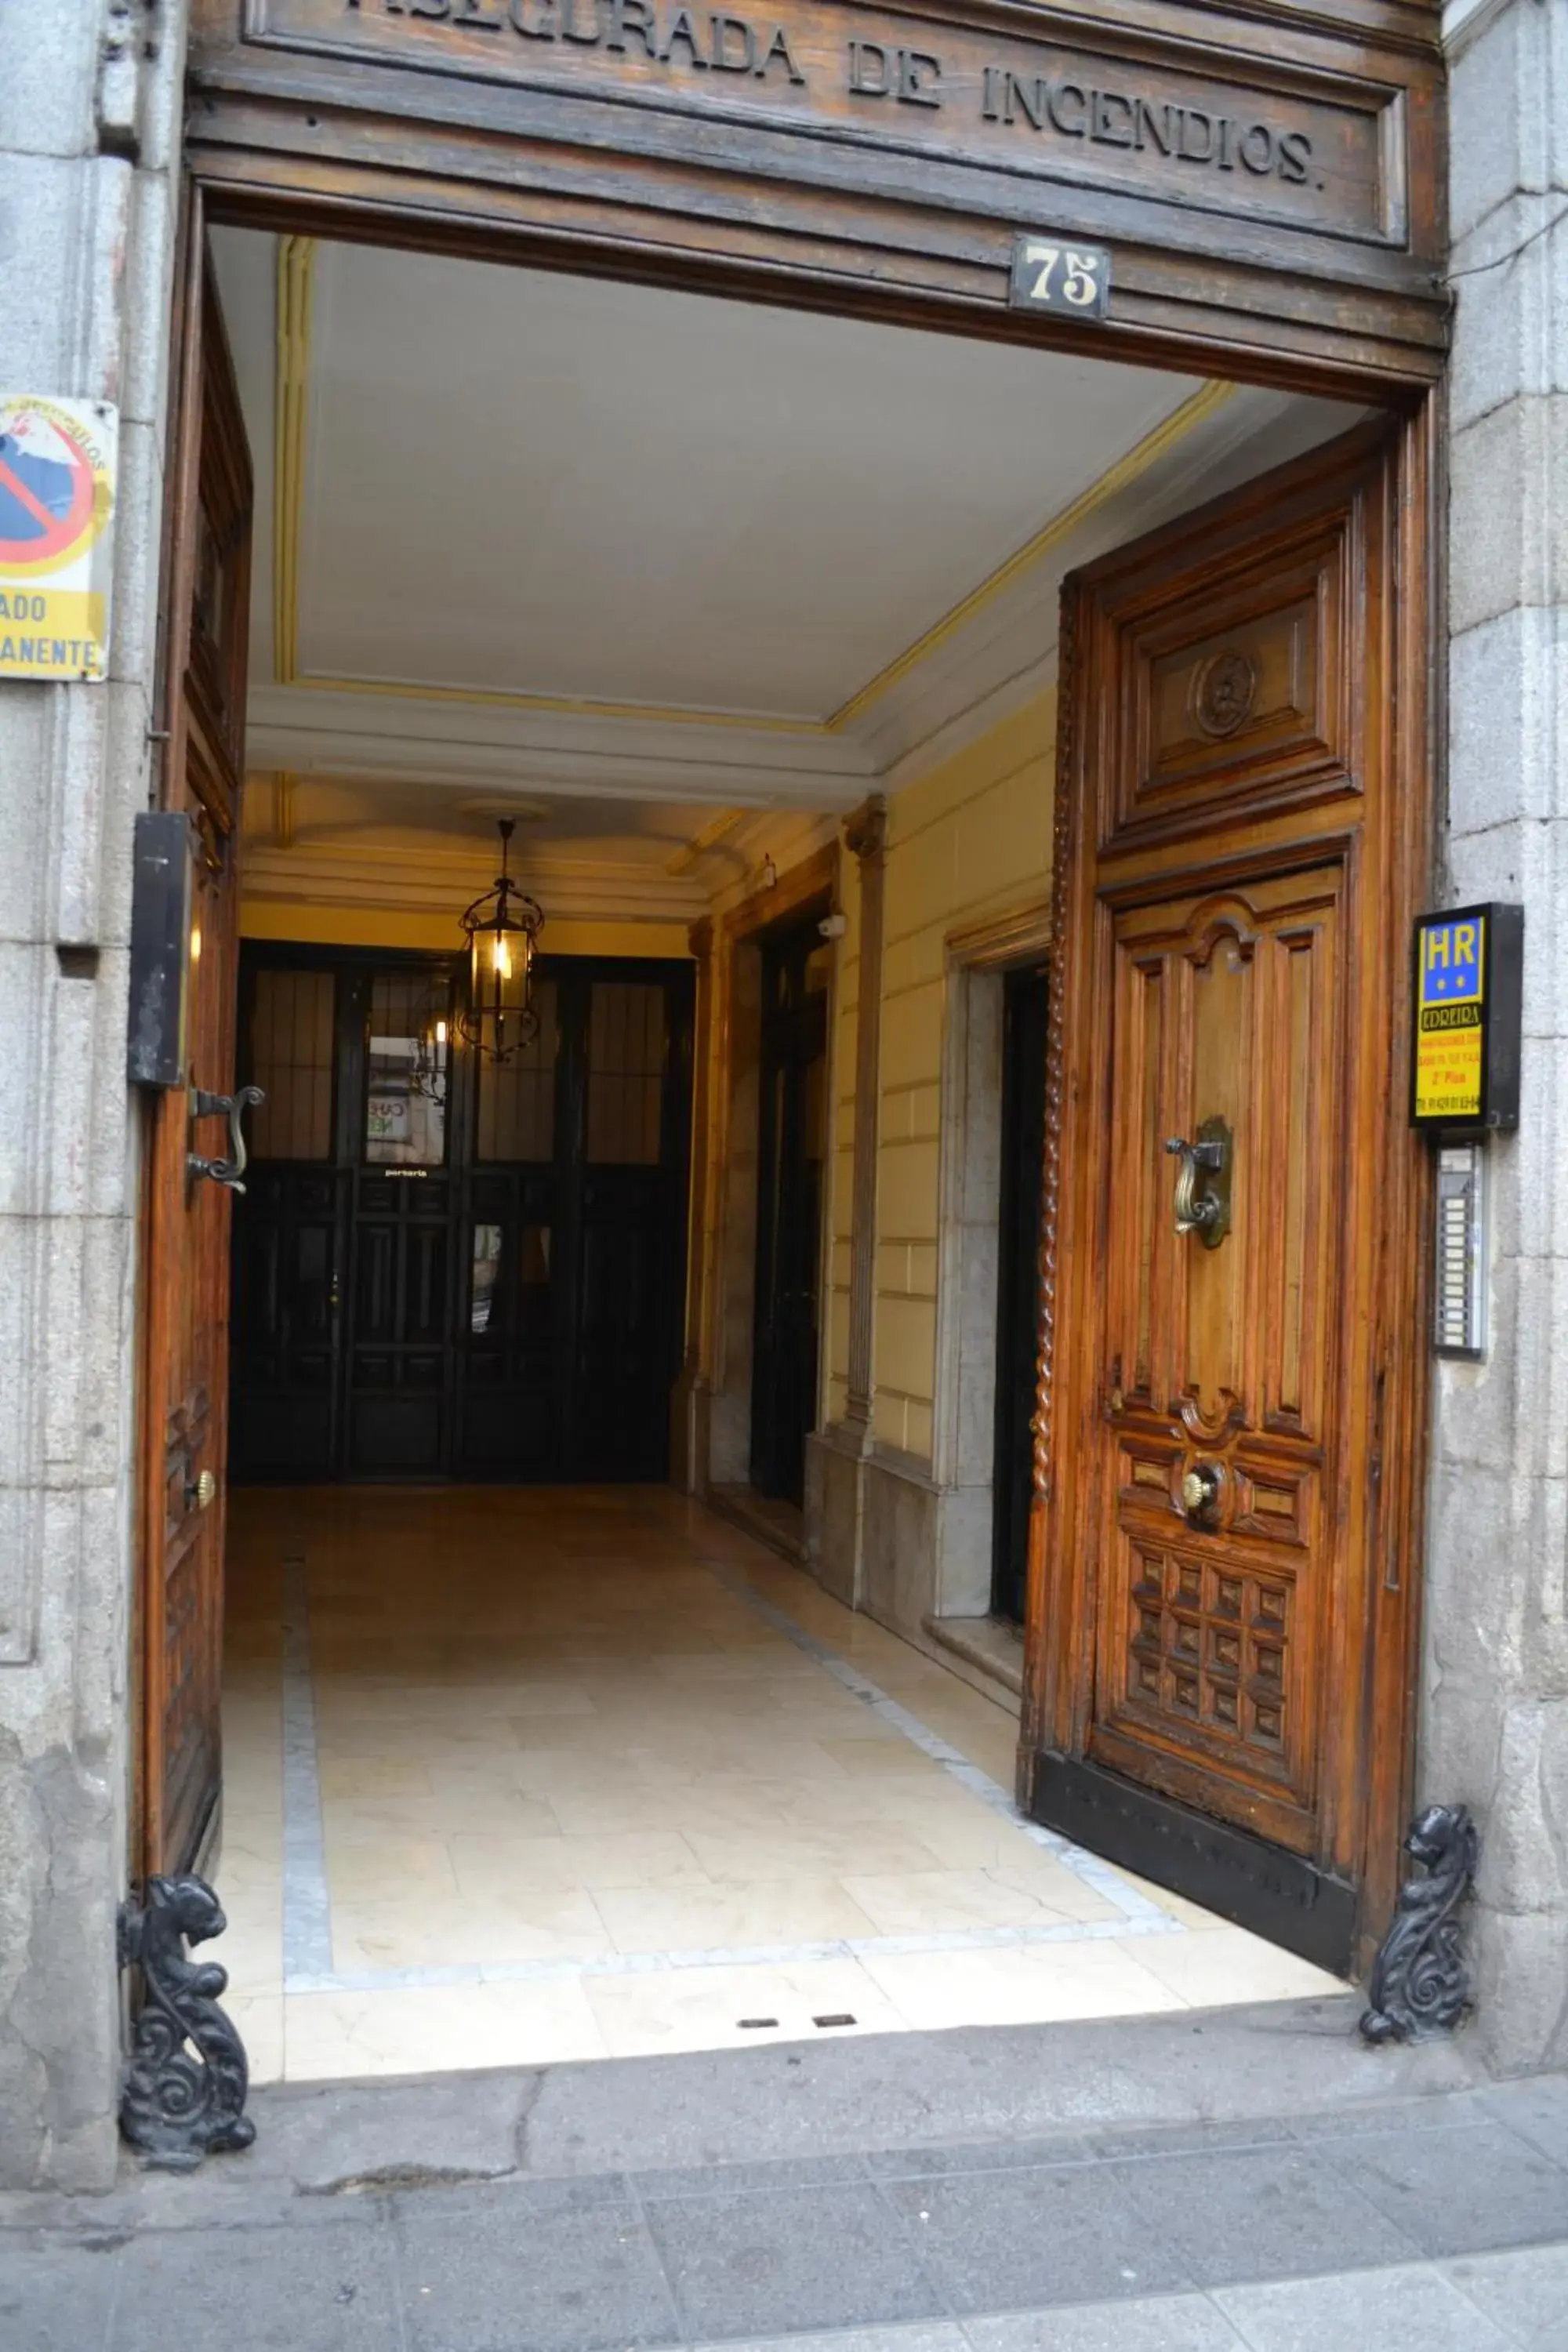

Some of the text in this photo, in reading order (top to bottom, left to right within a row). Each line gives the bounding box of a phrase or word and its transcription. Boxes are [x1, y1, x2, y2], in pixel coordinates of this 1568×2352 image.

[343, 0, 1326, 191] GURADA DE INCENDIOS.
[1025, 245, 1098, 306] 75
[0, 636, 97, 669] ANENTE
[1427, 924, 1475, 971] HR
